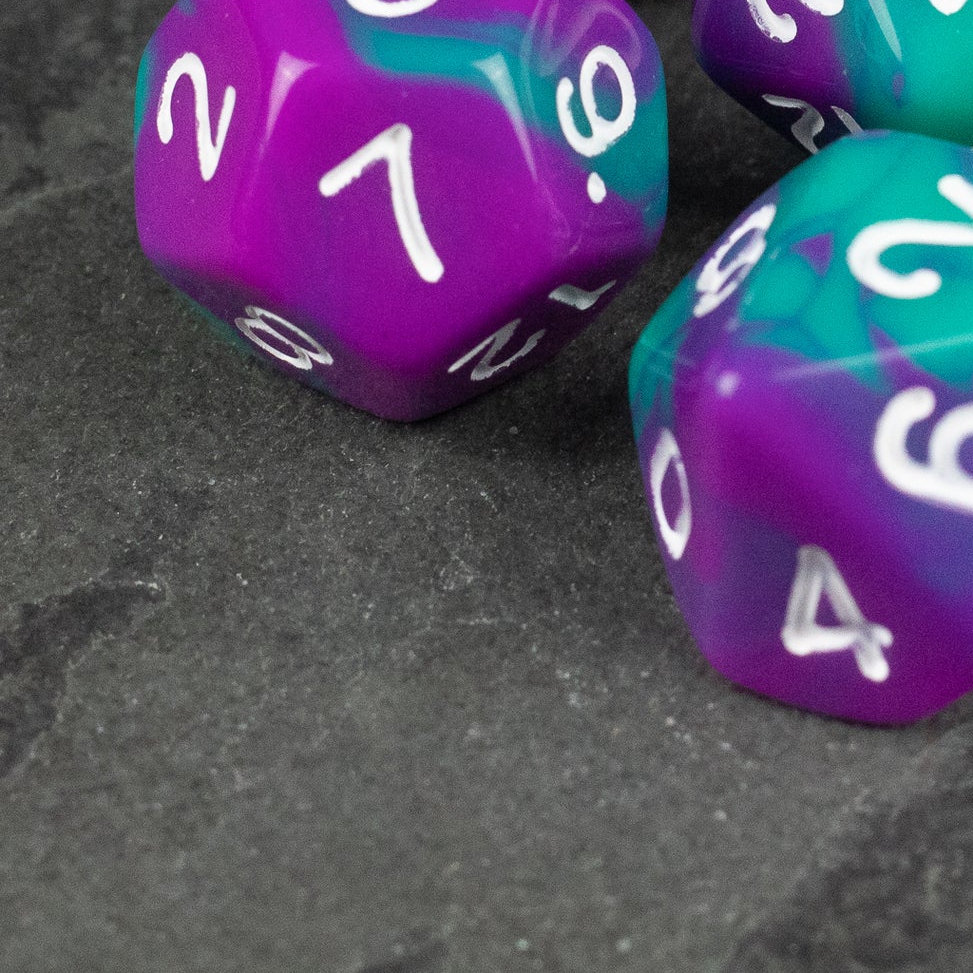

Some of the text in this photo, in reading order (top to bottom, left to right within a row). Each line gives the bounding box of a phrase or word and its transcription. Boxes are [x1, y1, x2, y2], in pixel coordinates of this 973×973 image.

[156, 52, 236, 181] 2
[319, 124, 444, 283] 7
[781, 544, 894, 683] 4
